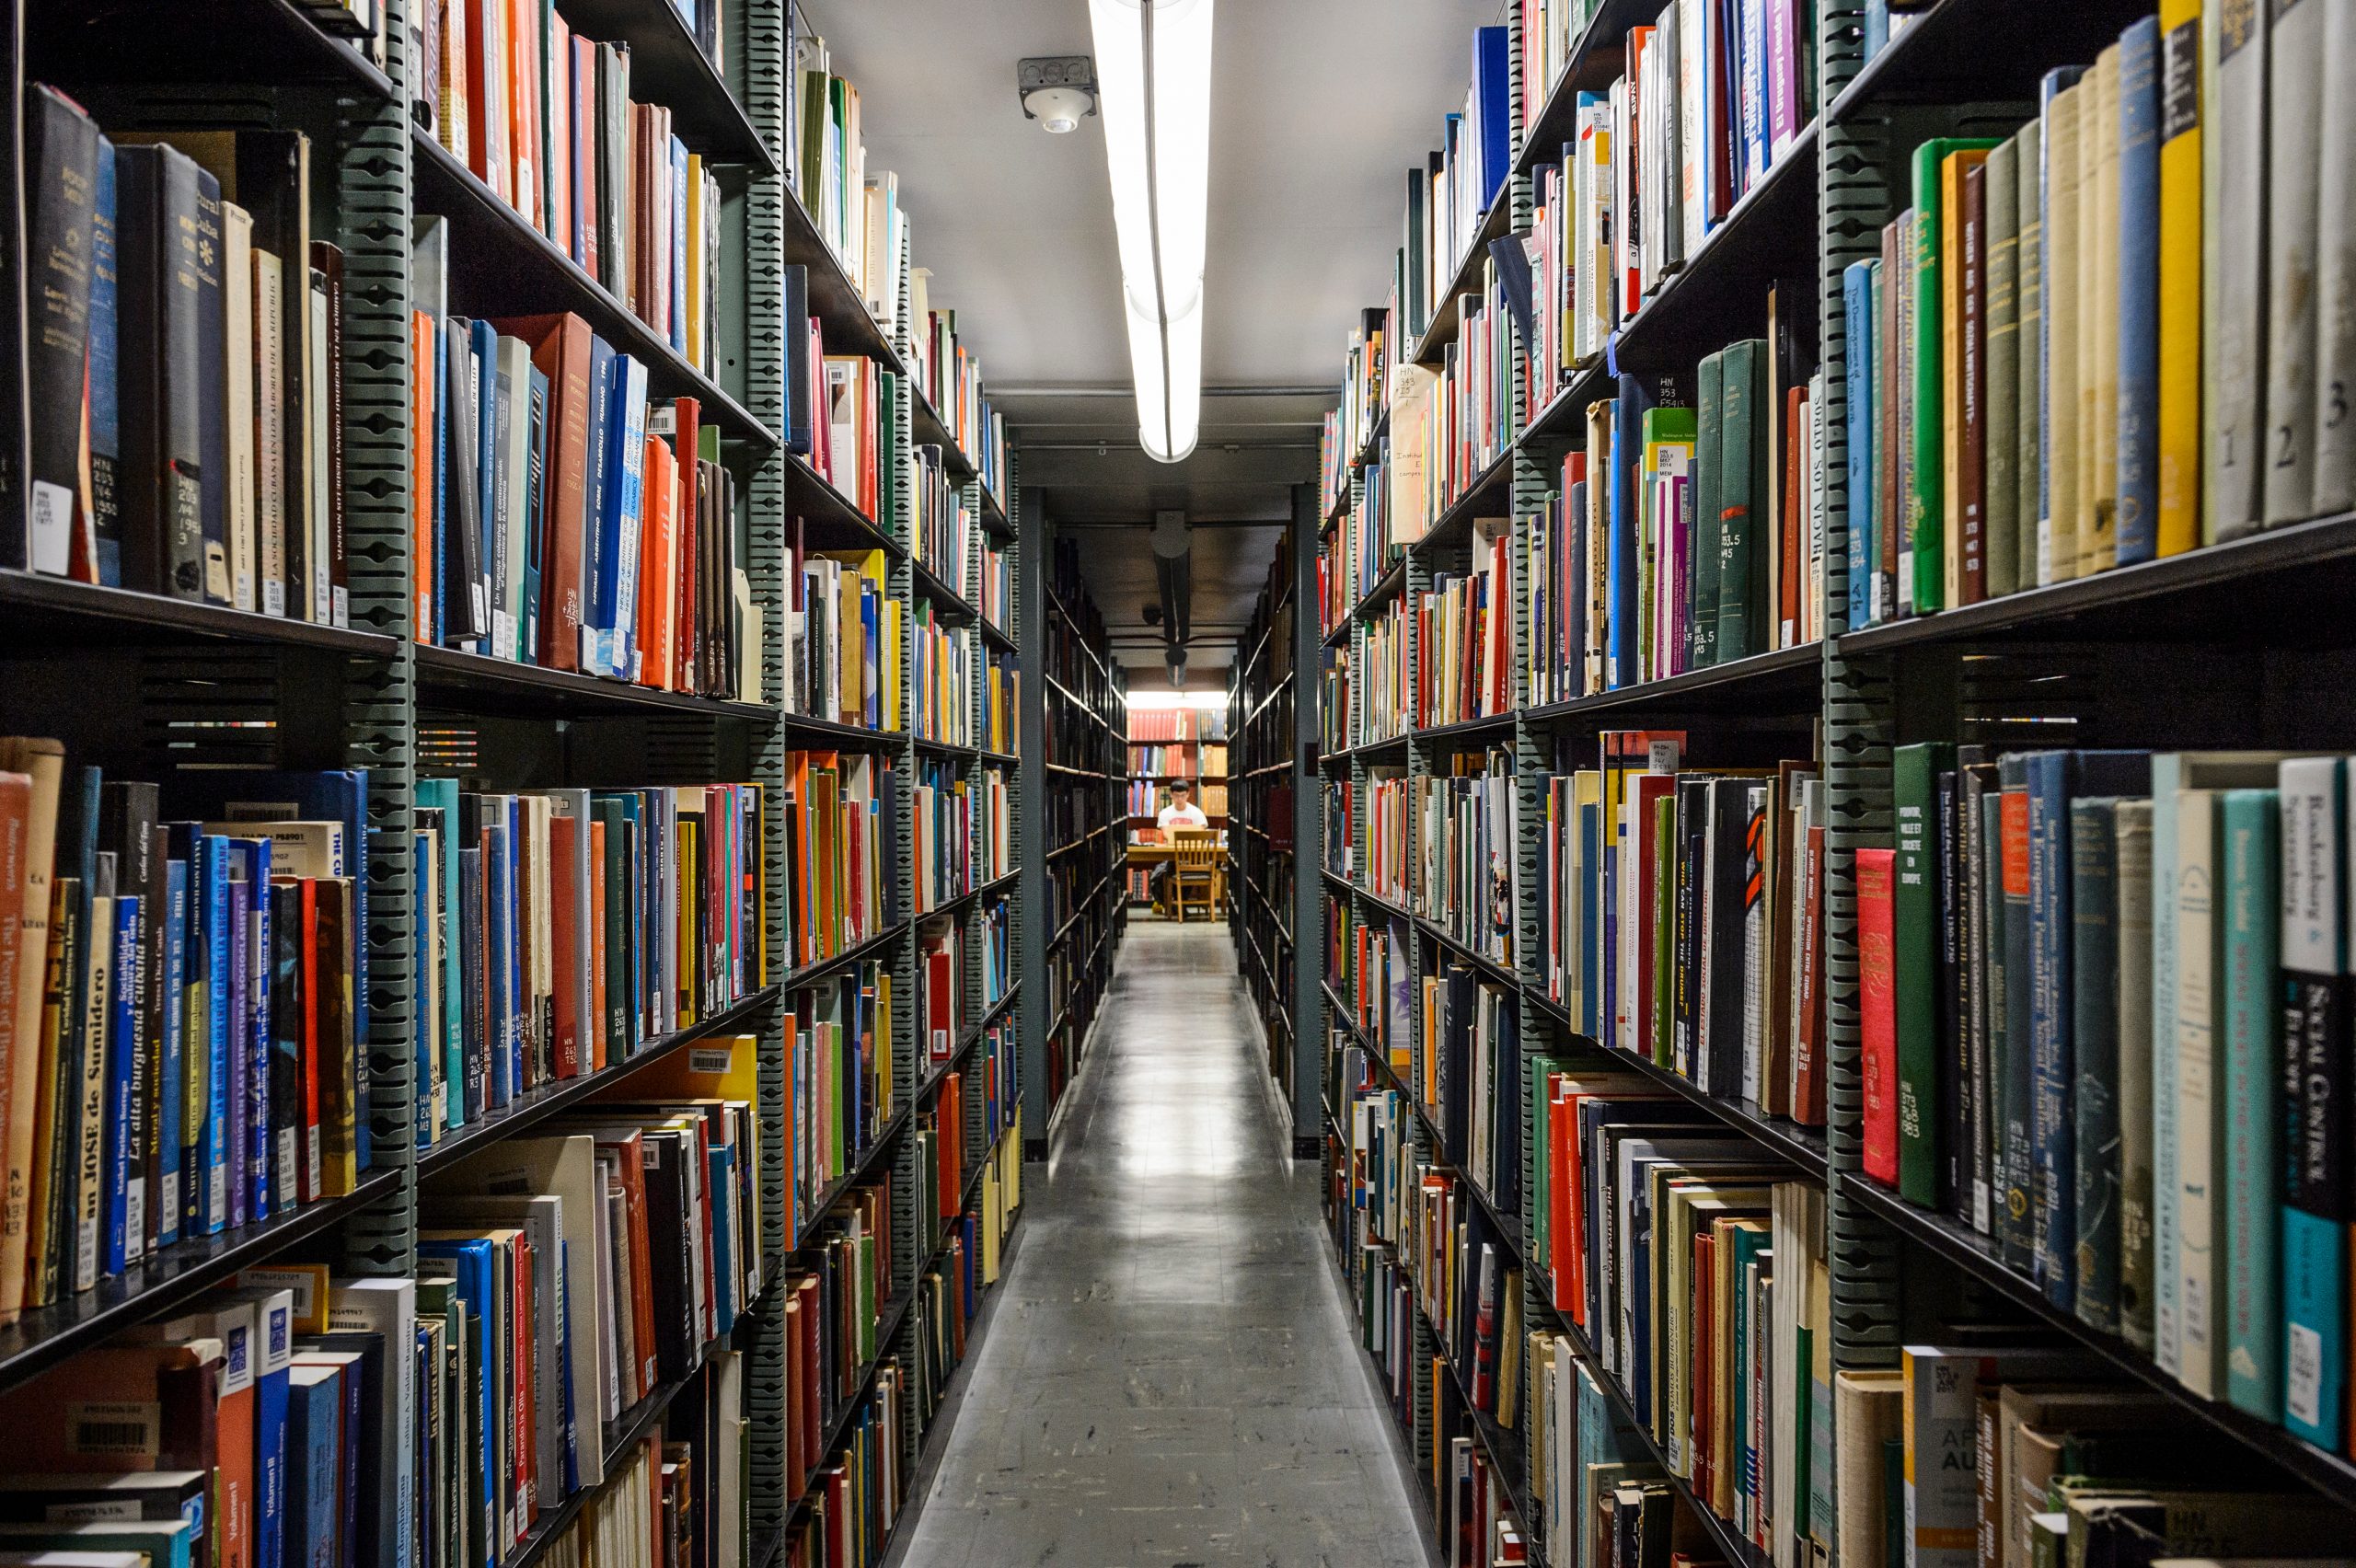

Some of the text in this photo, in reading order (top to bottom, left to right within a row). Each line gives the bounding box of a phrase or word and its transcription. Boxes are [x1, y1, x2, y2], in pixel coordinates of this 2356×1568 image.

[1774, 12, 1784, 54] desde
[1748, 74, 1758, 129] Uruguay
[1776, 55, 1784, 113] Uruguay
[1400, 367, 1414, 376] HN
[1400, 378, 1415, 386] 343
[1660, 377, 1673, 386] HN
[1660, 387, 1676, 398] 353
[2325, 381, 2349, 429] 3
[2223, 425, 2235, 467] 1
[2277, 425, 2296, 468] 2
[1813, 395, 1823, 554] HACIA LOS OTROS
[333, 834, 341, 855] THE
[134, 944, 146, 1005] cubana
[84, 968, 105, 1183] JOSE de Sumidero
[152, 1039, 161, 1098] sociedad
[129, 1097, 141, 1133] alta
[150, 1113, 159, 1155] Moral
[129, 1137, 142, 1160] La
[237, 1117, 245, 1170] CAMBIOS
[266, 1469, 275, 1517] Volumen
[229, 1490, 237, 1541] Volumen
